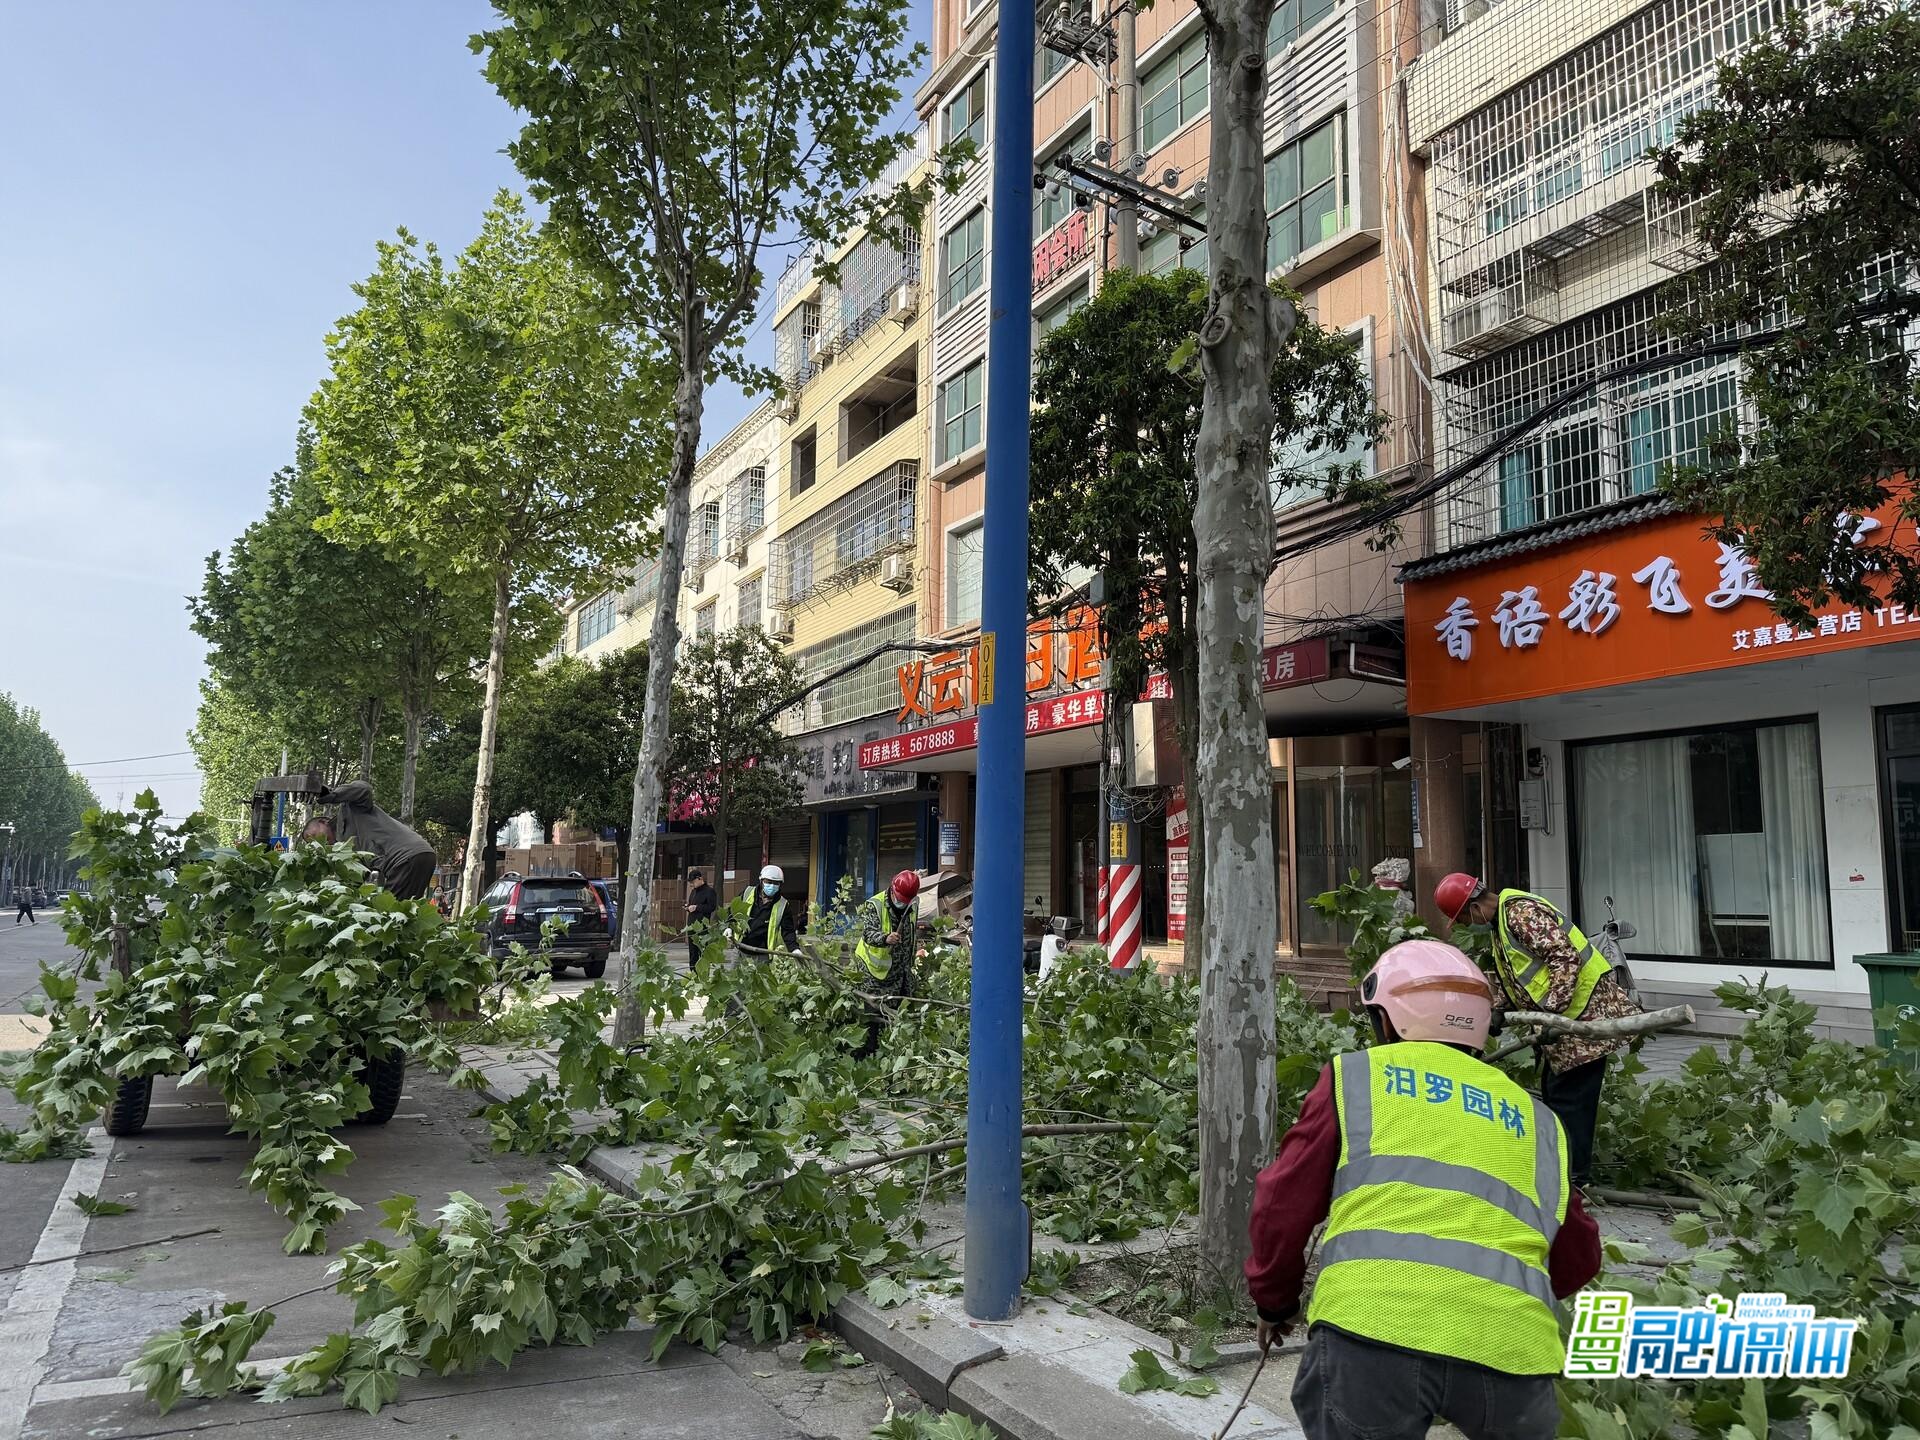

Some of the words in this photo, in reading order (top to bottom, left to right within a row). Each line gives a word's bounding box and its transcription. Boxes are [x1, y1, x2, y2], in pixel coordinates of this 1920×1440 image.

[1052, 694, 1112, 726] 豪华单
[1384, 1063, 1527, 1139] 汨罗园林
